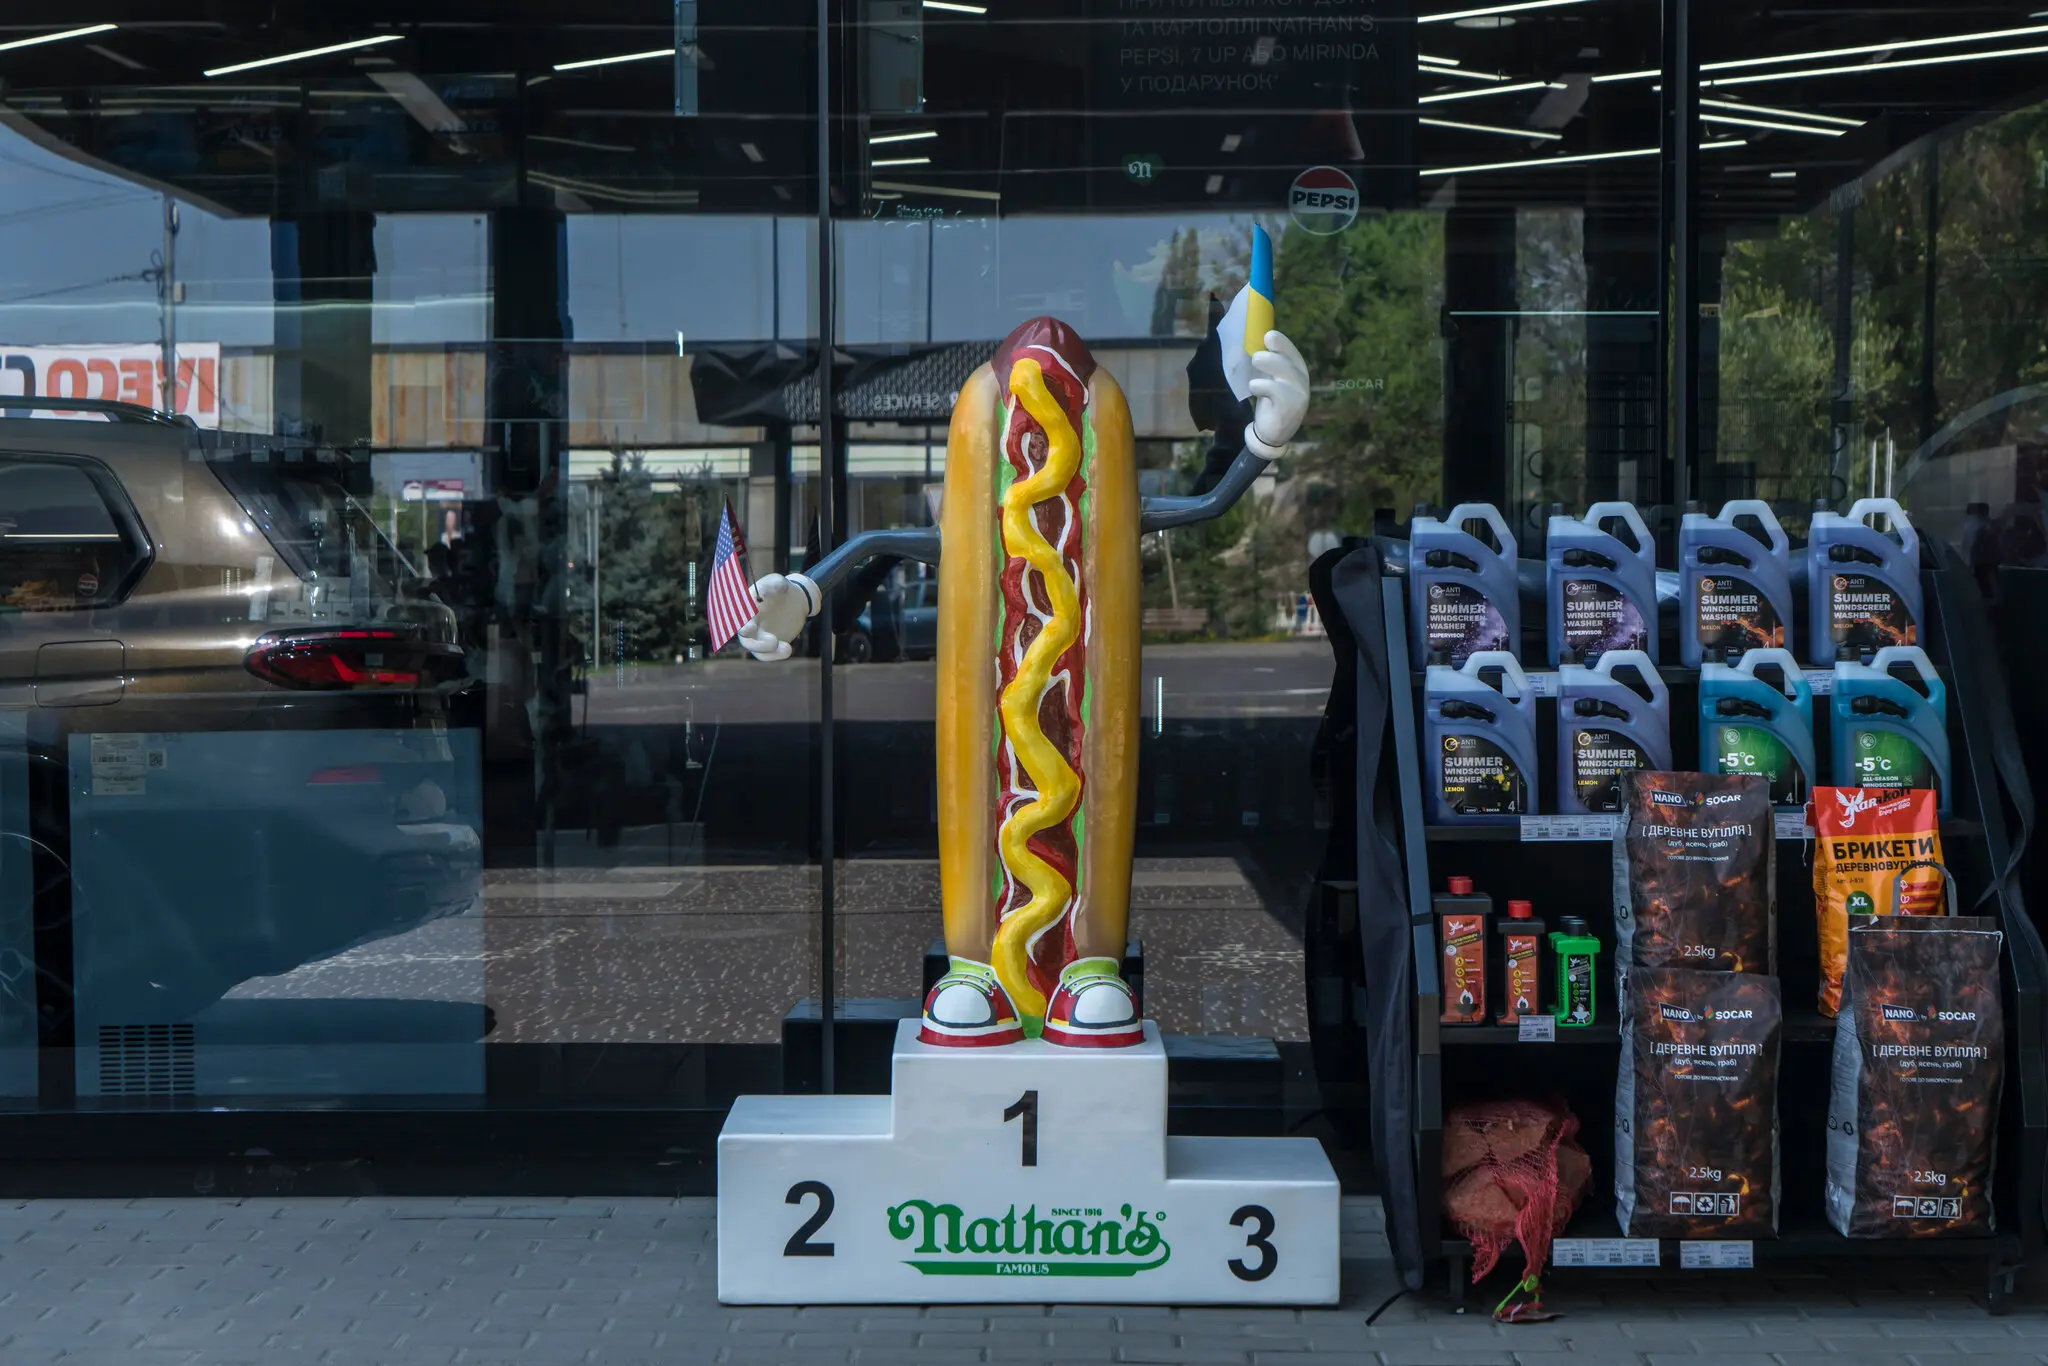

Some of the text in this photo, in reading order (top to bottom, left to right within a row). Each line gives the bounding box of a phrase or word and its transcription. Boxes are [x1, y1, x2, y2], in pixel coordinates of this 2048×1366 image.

[1208, 46, 1237, 63] UP
[1293, 44, 1380, 61] MIRINDA
[1292, 189, 1356, 211] PEPSI
[1336, 378, 1384, 390] SOCAR
[1701, 594, 1758, 605] SUMMER
[1833, 593, 1891, 603] SUMMER
[1430, 604, 1486, 614] SUMMER
[1566, 600, 1623, 611] SUMMER
[1578, 749, 1636, 759] SUMMER
[1719, 752, 1755, 767] -5°C
[1445, 756, 1503, 767] SUMMER
[1855, 755, 1892, 772] -5°C
[1577, 768, 1616, 776] WASHER
[1654, 793, 1681, 804] NANO
[1706, 794, 1742, 806] SOCAR
[1785, 792, 1794, 804] 4
[1508, 800, 1516, 812] 4
[1648, 824, 1745, 838] ДЕРЕВНЕ ВУГІЛЛЯ
[1832, 837, 1935, 860] БРИКЕТИ
[1851, 896, 1868, 907] XL
[1684, 944, 1716, 960] 2.5kg
[1662, 1008, 1690, 1019] NANO
[1715, 1010, 1753, 1020] SOCAR
[1885, 1009, 1913, 1019] NANO
[1938, 1011, 1976, 1021] SOCAR
[1656, 1044, 1757, 1056] ДЕРЕВНЕ ВУГІЛЛЯ
[1880, 1045, 1981, 1058] ДЕРЕВНЕ ВУГІЛЛЯ
[1003, 1089, 1038, 1167] 1
[1689, 1166, 1721, 1182] 2.5kg
[1914, 1170, 1946, 1186] 2.5kg
[1051, 1208, 1103, 1217] SINCE 1916
[783, 1180, 836, 1258] 2
[887, 1199, 1162, 1257] Nathan's
[1227, 1204, 1279, 1283] 3
[996, 1263, 1050, 1275] FAMOUS
